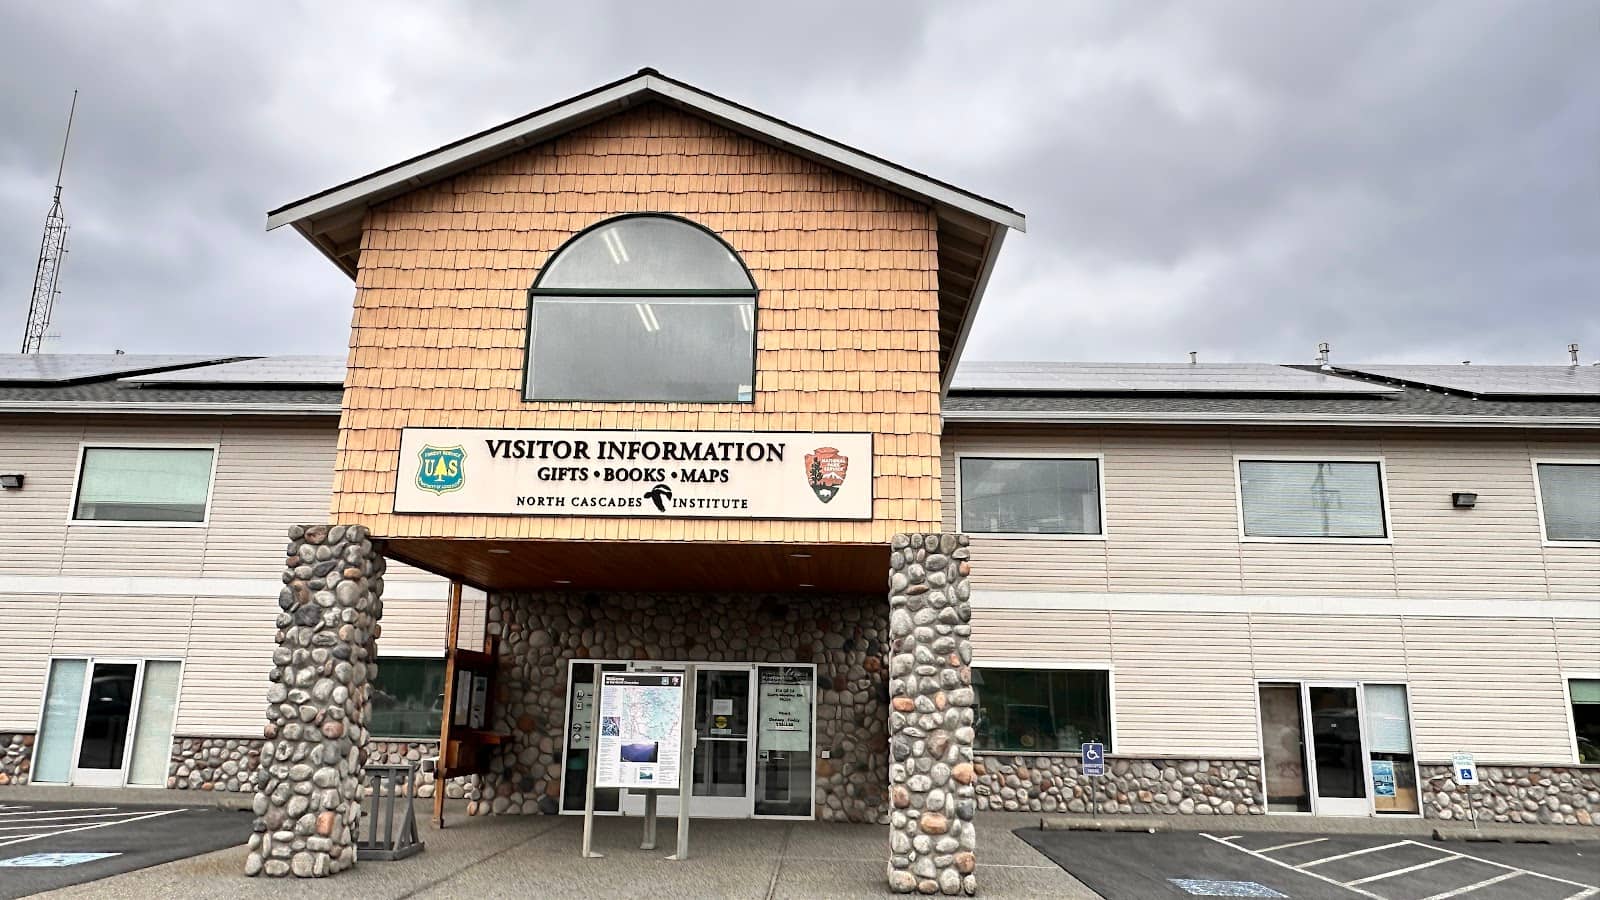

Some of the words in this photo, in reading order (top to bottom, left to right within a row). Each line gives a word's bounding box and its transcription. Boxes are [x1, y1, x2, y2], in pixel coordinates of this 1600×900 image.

[485, 440, 590, 460] VISITOR
[597, 441, 785, 462] INFORMATION
[538, 467, 588, 481] GIFTS
[604, 467, 665, 482] BOOKS
[680, 469, 728, 482] MAPS
[516, 496, 565, 507] NORTH
[571, 497, 642, 507] CASCADES
[672, 498, 748, 509] INSTITUTE
